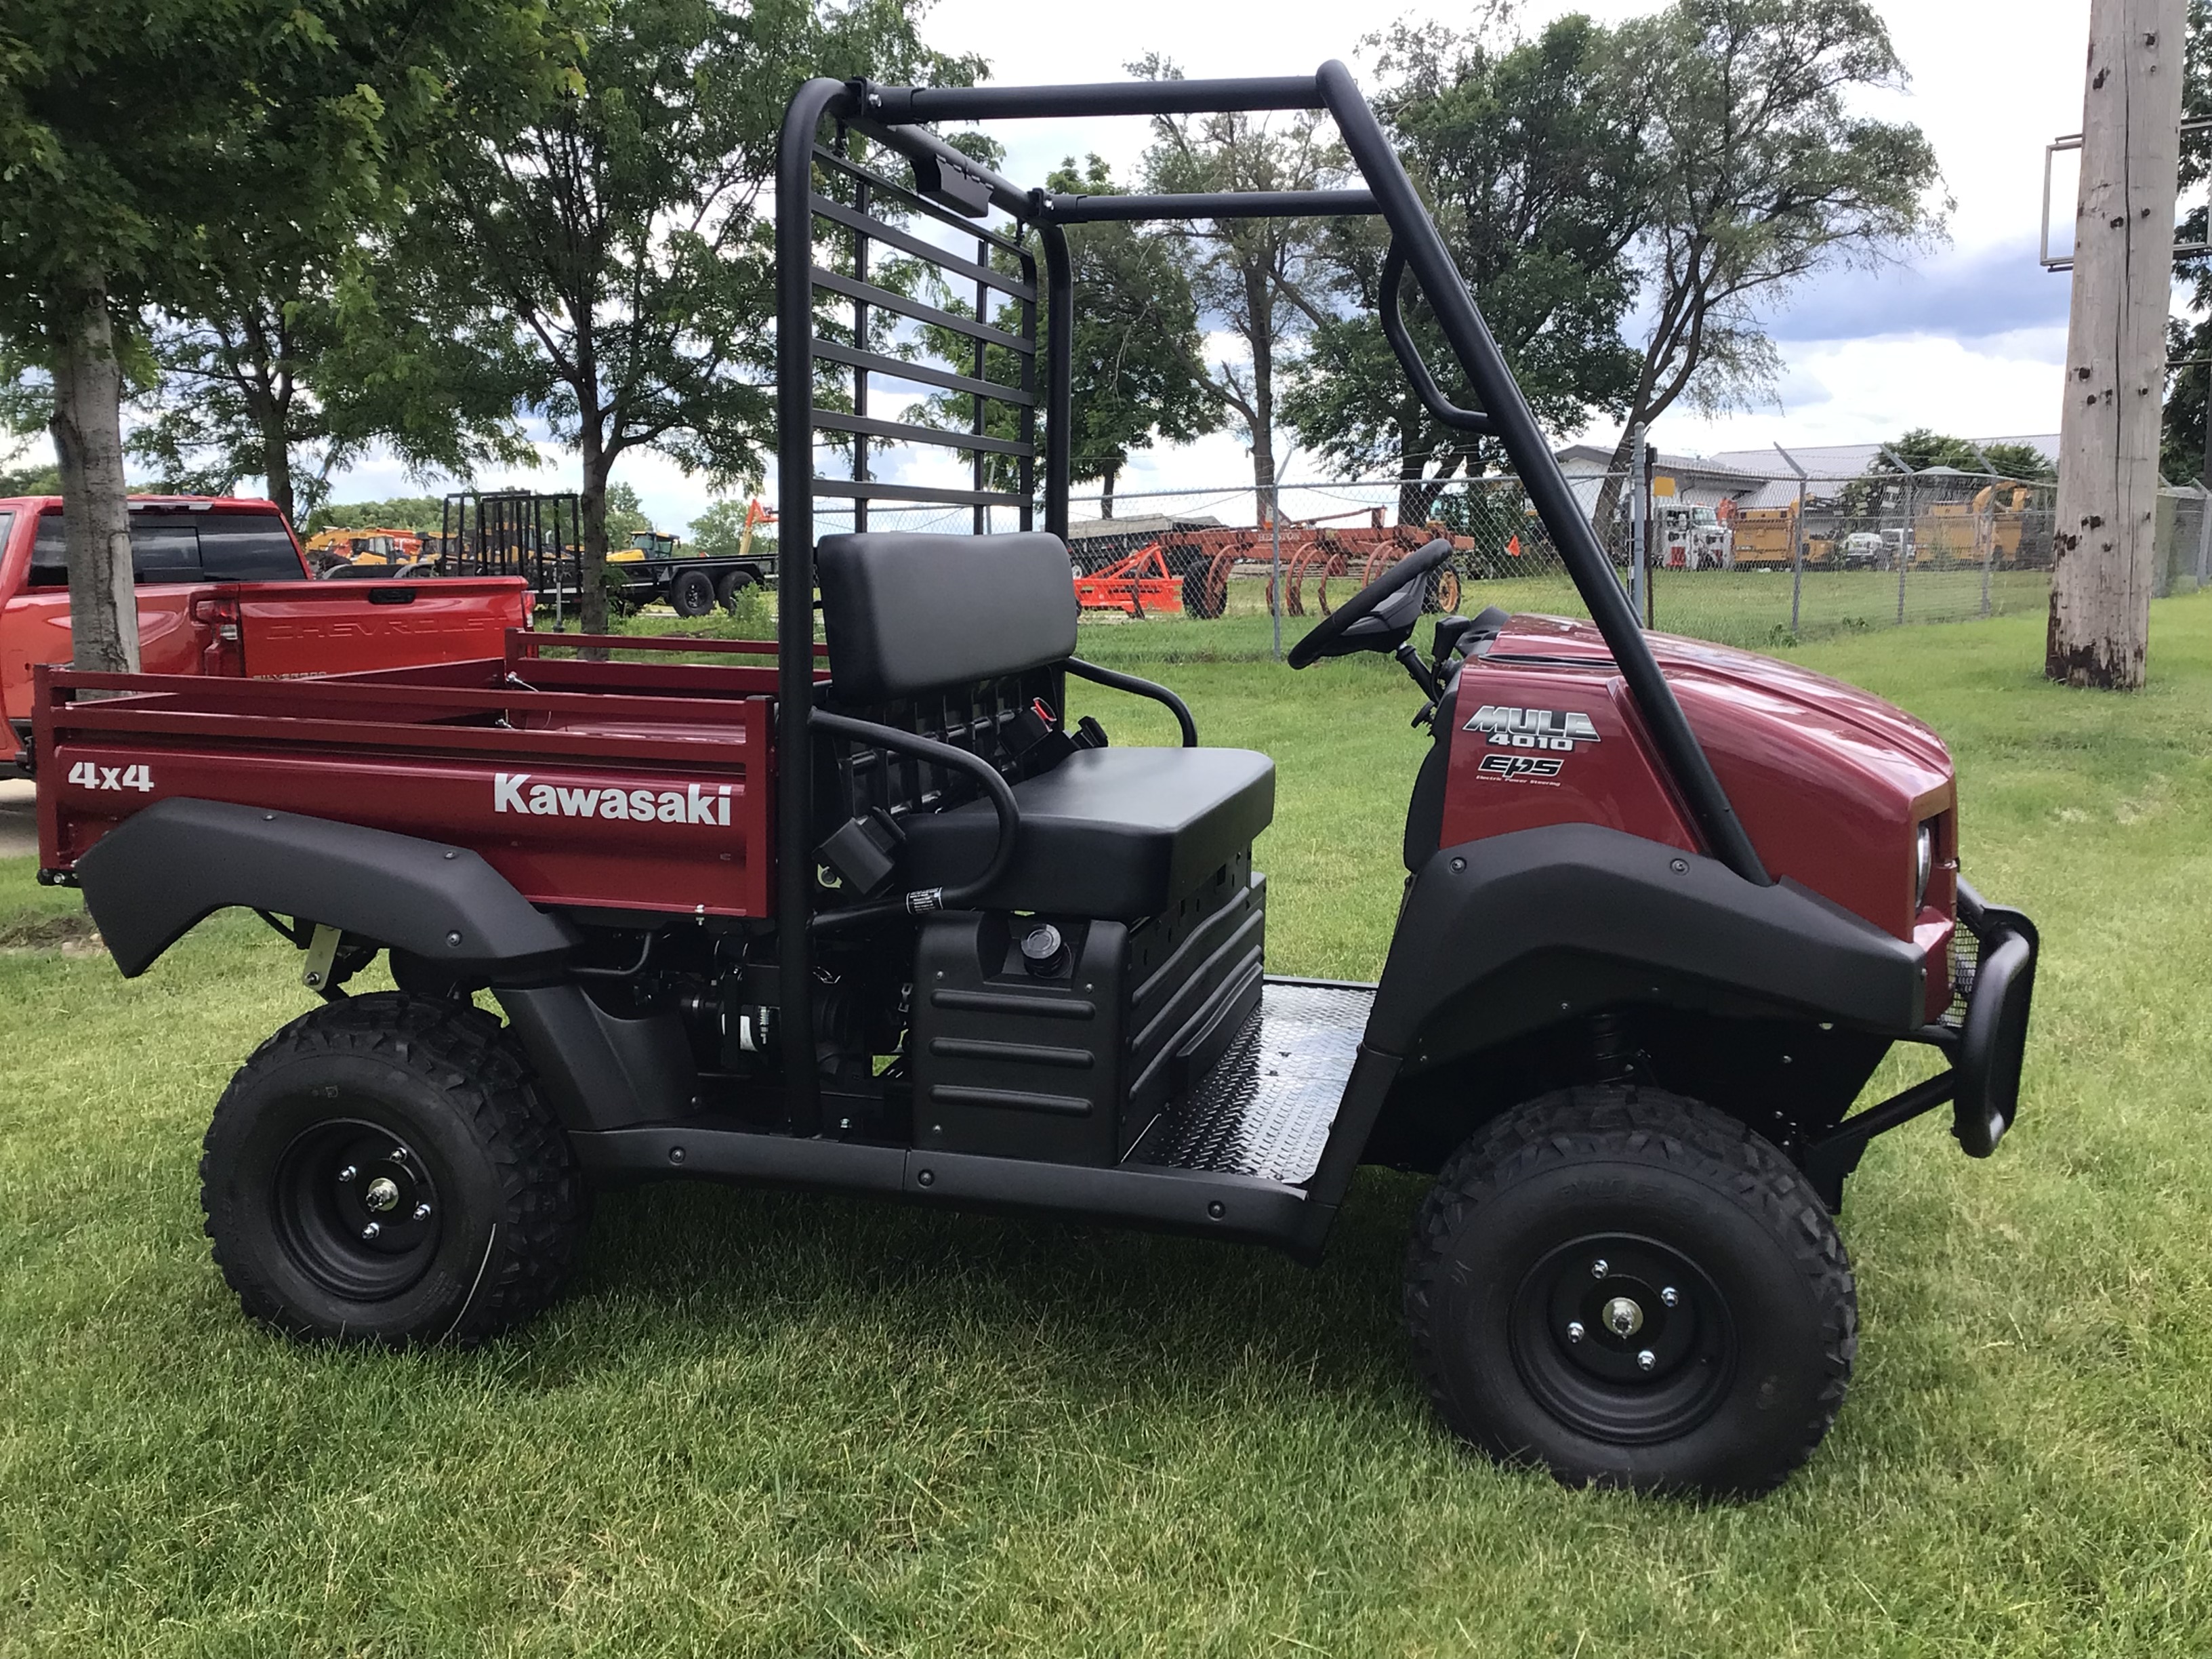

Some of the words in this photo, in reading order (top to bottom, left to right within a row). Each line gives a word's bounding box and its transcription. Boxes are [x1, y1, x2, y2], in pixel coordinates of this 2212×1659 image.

[266, 617, 508, 640] CHEVROLET
[1462, 705, 1601, 742] MULE
[1488, 733, 1574, 752] 4010
[68, 761, 155, 792] 4x4
[1478, 754, 1564, 778] EPS
[494, 773, 732, 826] Kawasaki
